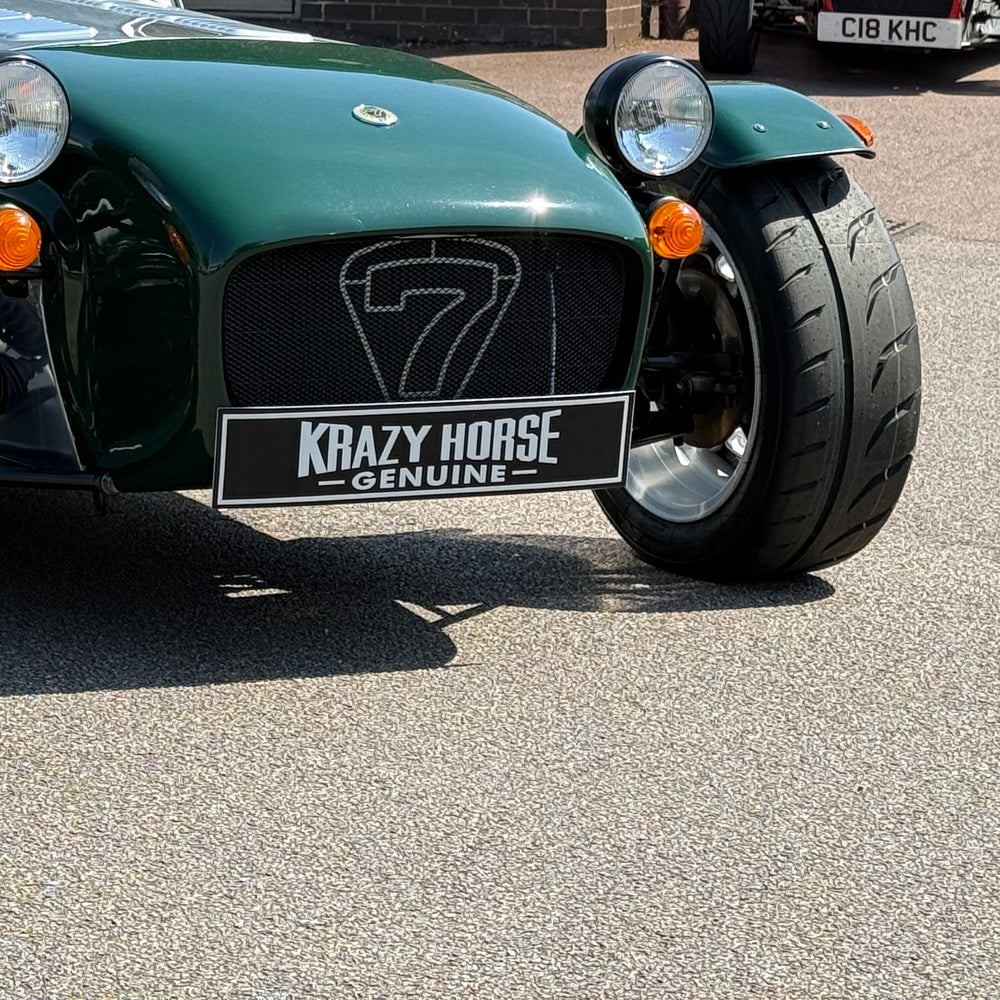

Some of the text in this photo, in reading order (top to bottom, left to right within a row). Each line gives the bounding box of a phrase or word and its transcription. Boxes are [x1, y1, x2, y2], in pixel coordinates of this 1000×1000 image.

[841, 17, 938, 42] C18 KHC
[297, 409, 562, 479] KRAZY HORSE
[351, 464, 506, 491] GENUINE
